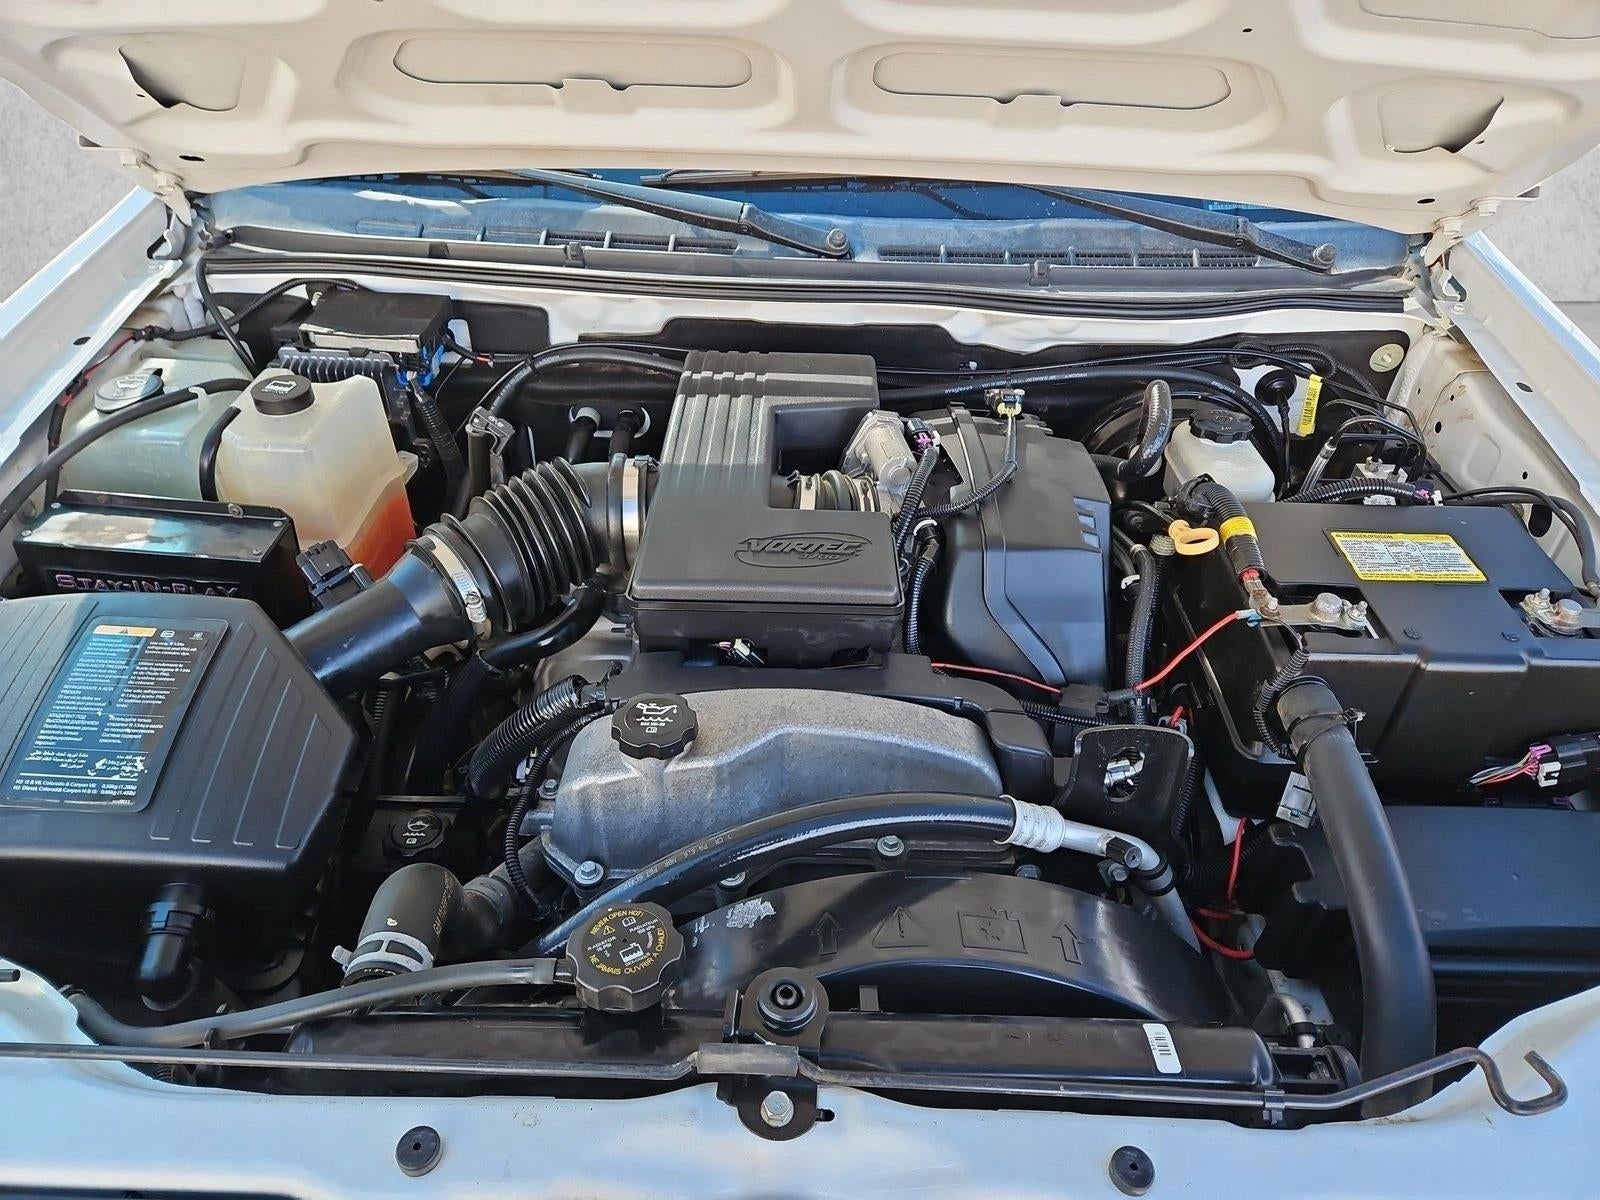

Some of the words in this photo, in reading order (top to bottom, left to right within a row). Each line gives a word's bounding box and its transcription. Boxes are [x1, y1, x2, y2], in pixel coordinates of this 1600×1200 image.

[747, 538, 863, 556] VORTEC
[55, 574, 239, 598] STAY-IN-PLAY
[590, 917, 610, 935] NEVER
[608, 910, 628, 920] OPEN
[627, 909, 645, 918] HOT!
[587, 936, 617, 951] RADIATOR
[589, 954, 600, 966] NE
[597, 961, 621, 975] JAMAIS
[623, 957, 655, 975] OUVRIR
